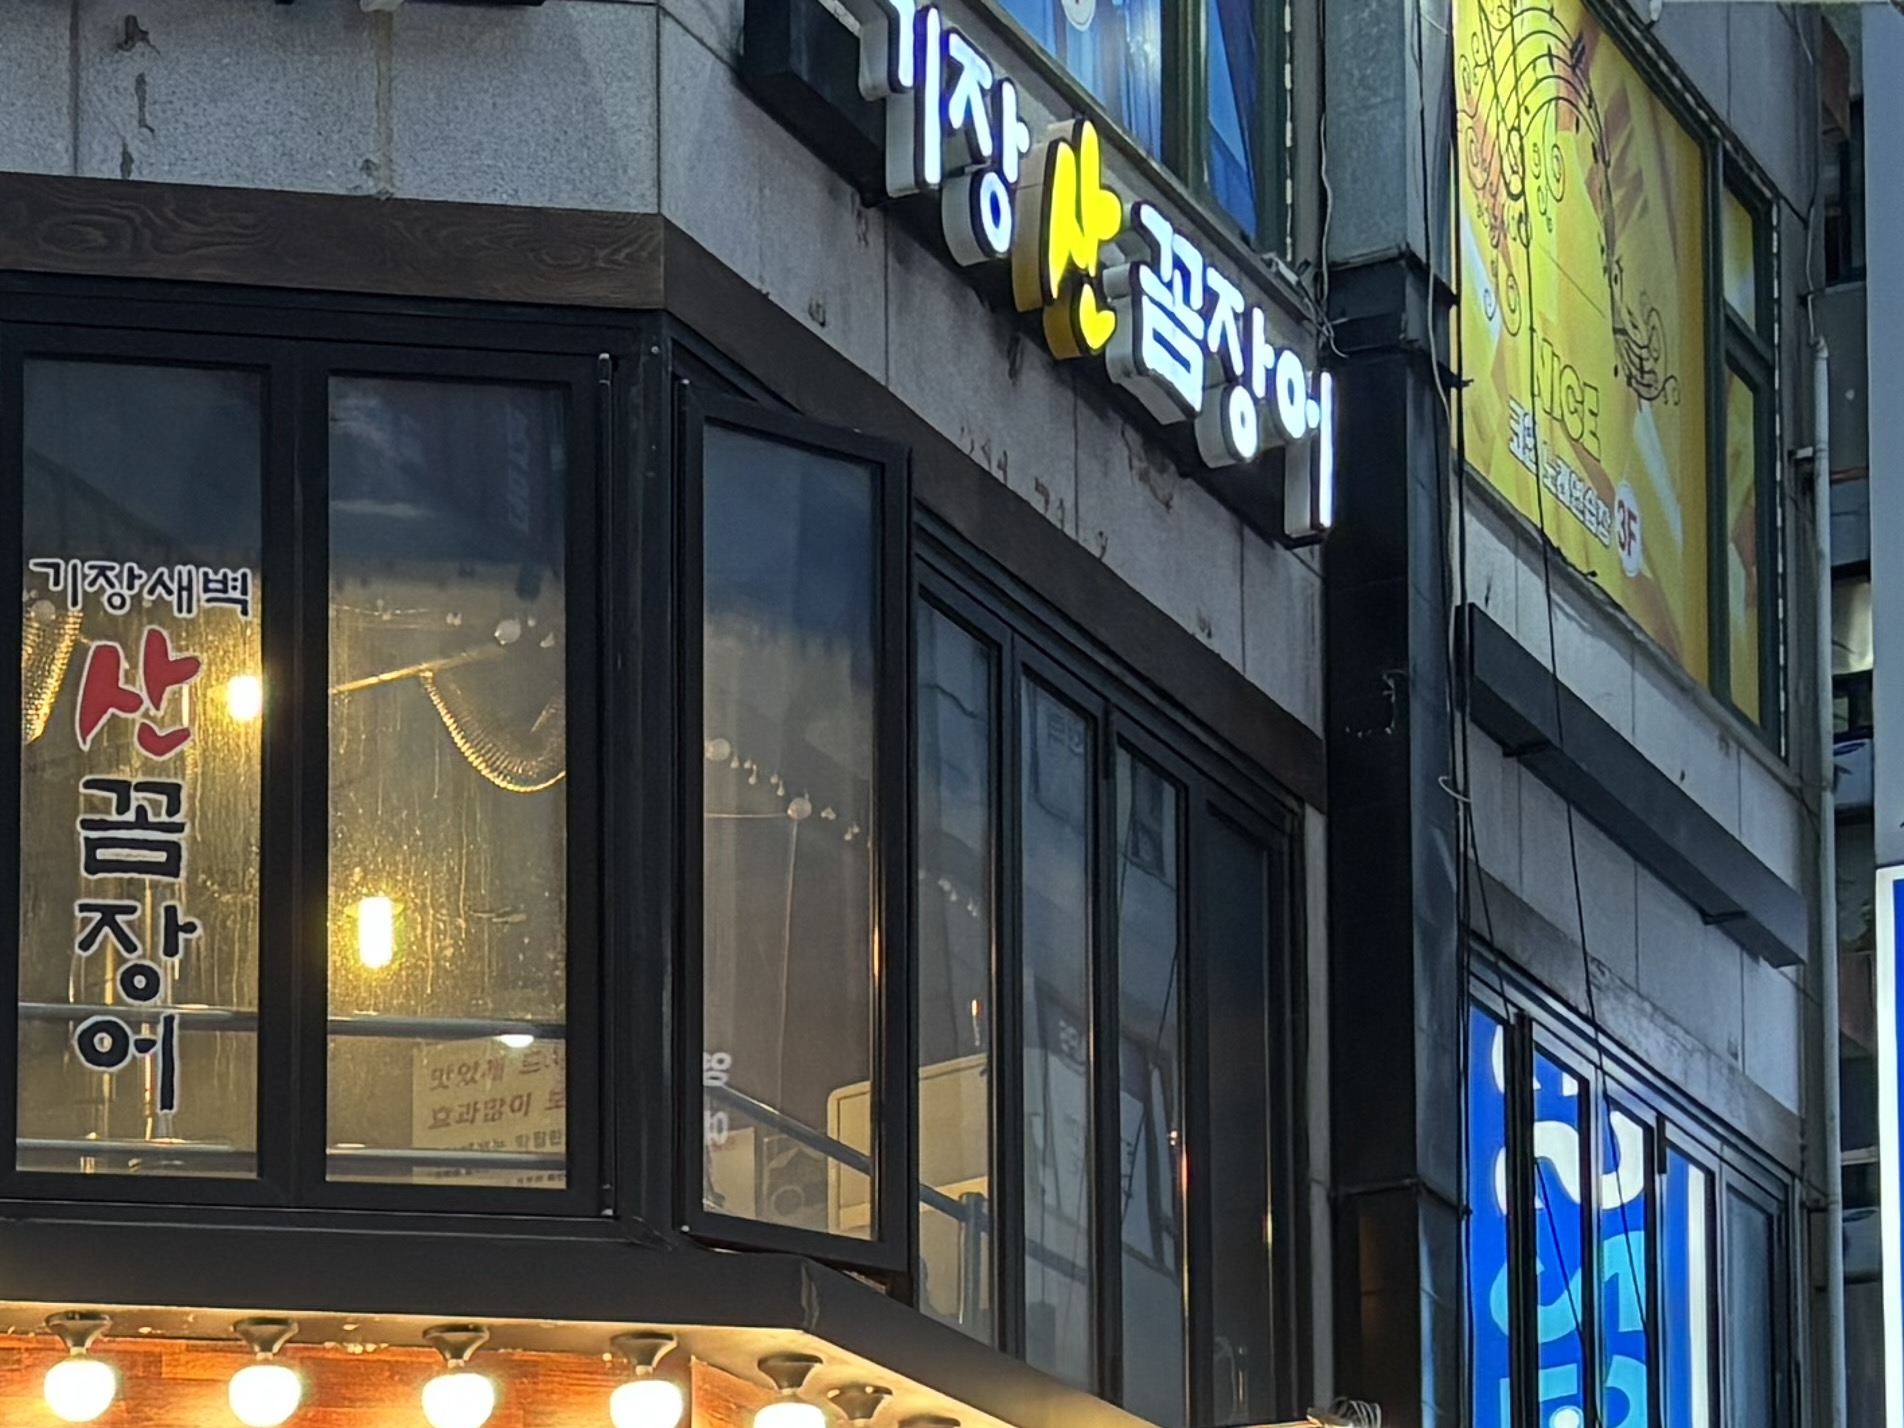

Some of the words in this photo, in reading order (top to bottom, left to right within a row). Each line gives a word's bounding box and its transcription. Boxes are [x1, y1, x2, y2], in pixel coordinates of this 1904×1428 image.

[1047, 120, 1123, 352] 산
[1132, 202, 1336, 530] 꼼장어
[1534, 334, 1601, 463] NICE
[28, 558, 252, 618] 기장새벽
[1618, 499, 1638, 558] 3F
[77, 625, 202, 758] 산
[75, 776, 202, 1116] 꼼장어
